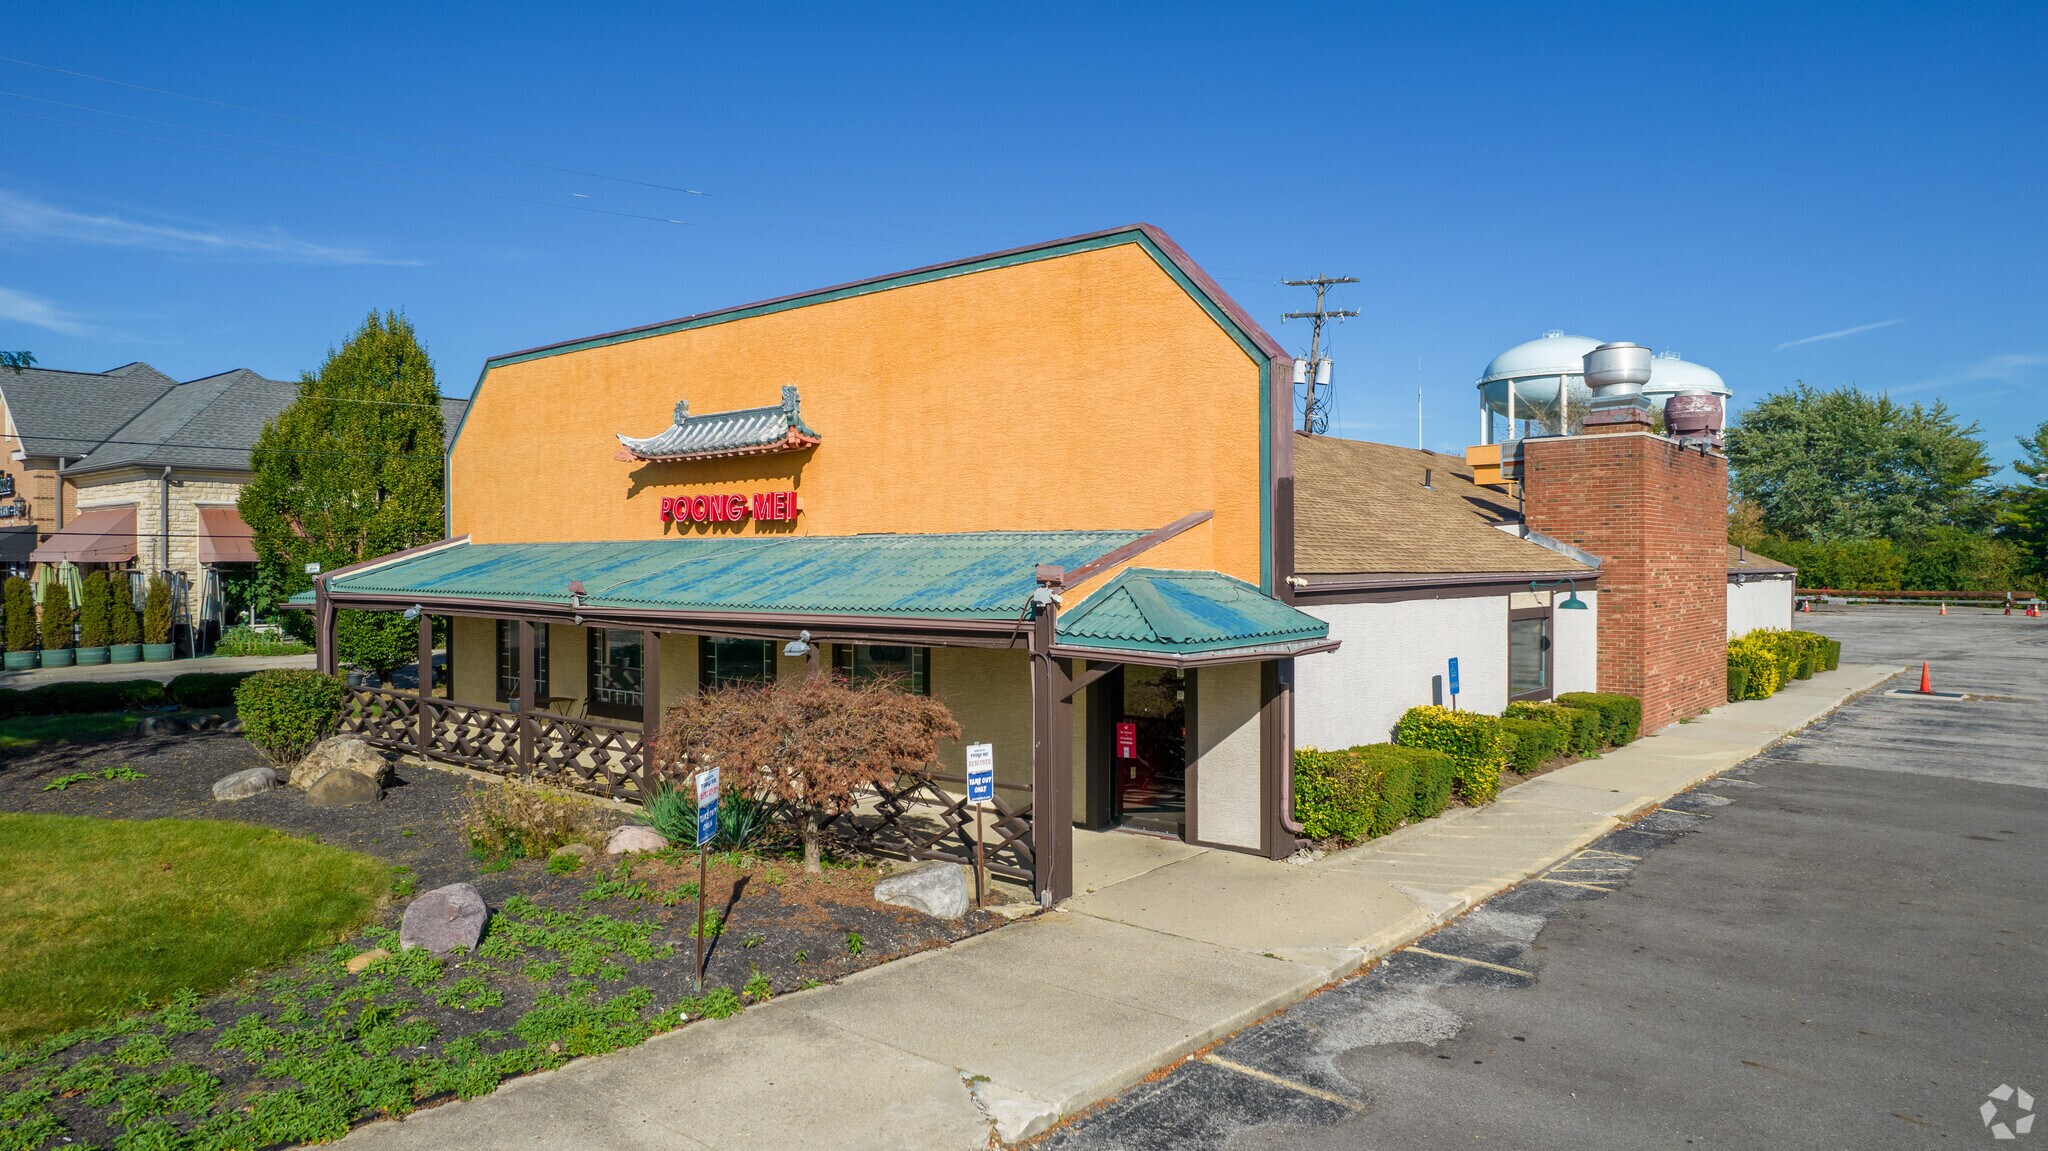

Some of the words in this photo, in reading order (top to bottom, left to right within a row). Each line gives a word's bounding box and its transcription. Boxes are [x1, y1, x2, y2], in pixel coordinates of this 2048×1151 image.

[660, 494, 748, 522] POONG
[752, 491, 797, 520] MEI
[969, 778, 981, 786] TAKE
[982, 776, 992, 784] OUT
